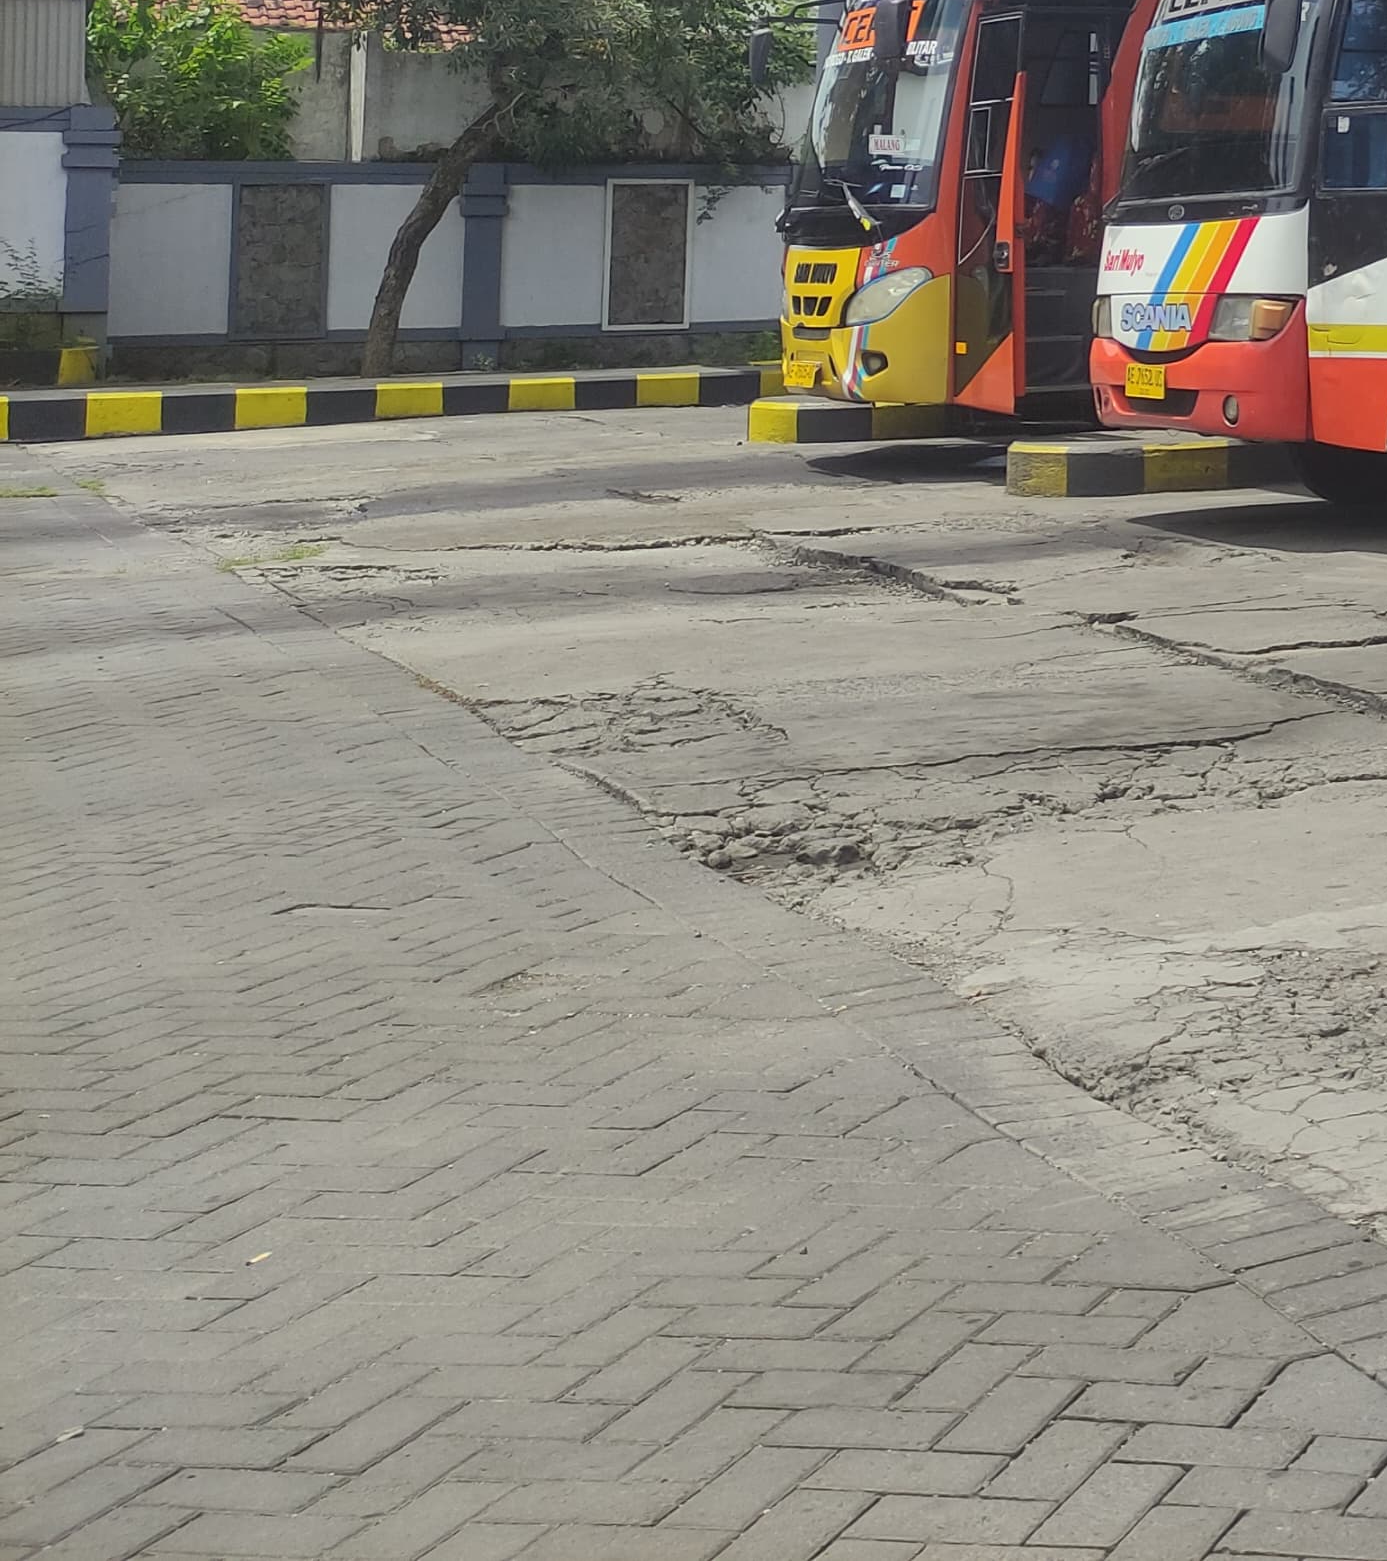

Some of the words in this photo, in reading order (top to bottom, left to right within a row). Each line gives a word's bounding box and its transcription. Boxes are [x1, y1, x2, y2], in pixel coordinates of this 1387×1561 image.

[873, 138, 901, 151] MALANG
[1104, 249, 1121, 271] Sari
[1118, 248, 1145, 277] Mulyo
[1120, 302, 1192, 333] SCANIA
